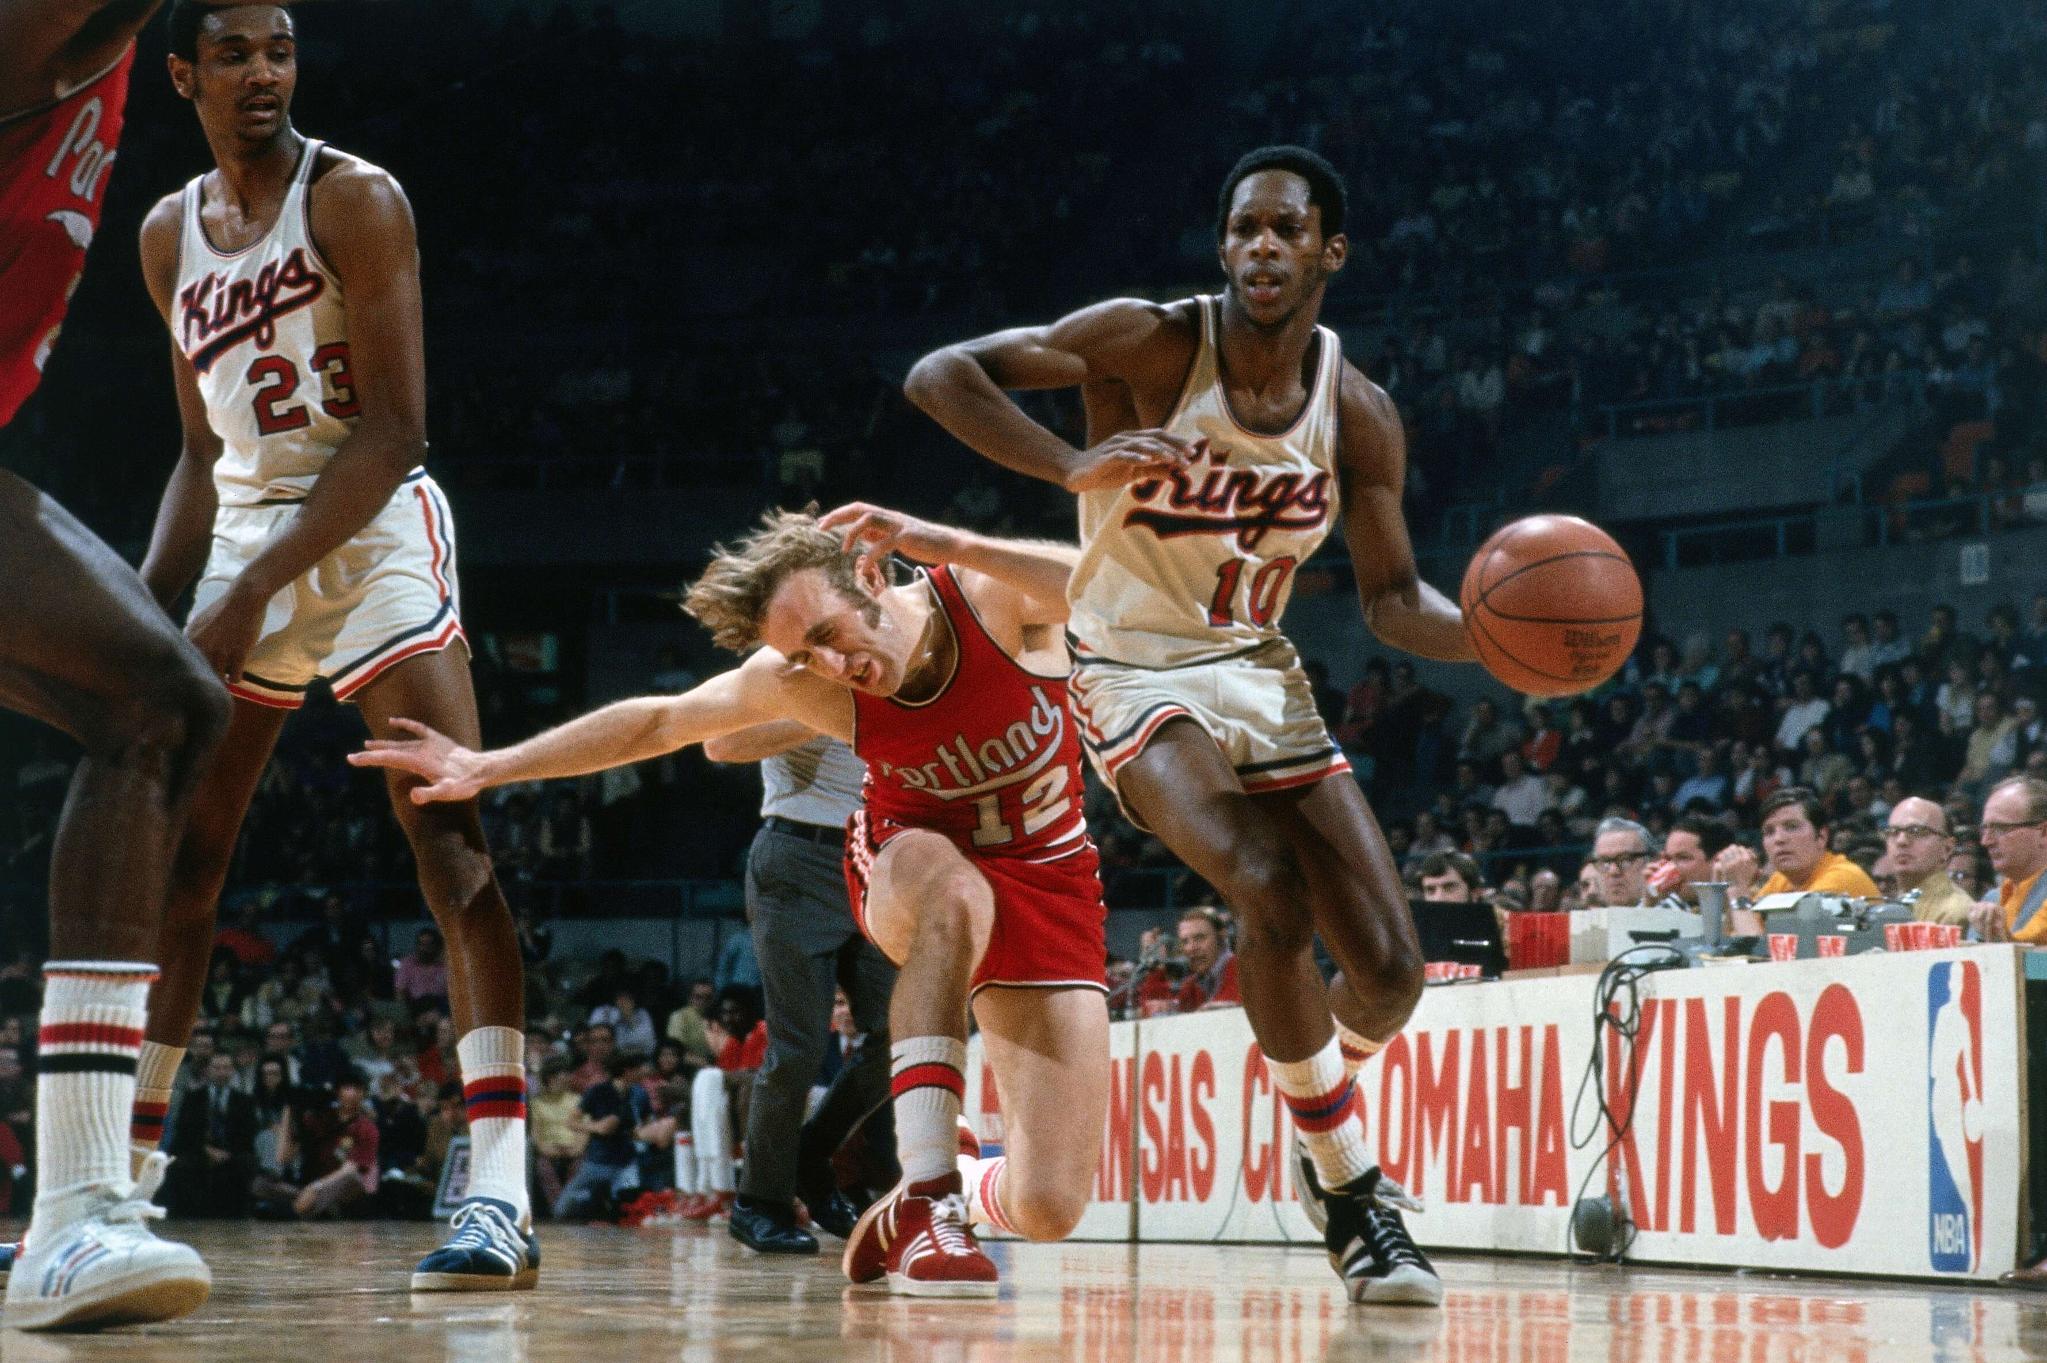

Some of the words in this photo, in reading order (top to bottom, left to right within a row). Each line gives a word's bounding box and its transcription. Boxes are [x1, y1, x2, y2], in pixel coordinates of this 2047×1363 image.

[177, 247, 326, 374] Kings
[246, 341, 361, 436] 23
[1208, 556, 1298, 628] 10
[971, 765, 1072, 848] 12
[1377, 1026, 1570, 1207] OMAHA
[1606, 984, 1865, 1250] KINGS
[1933, 1213, 1966, 1255] NBA
